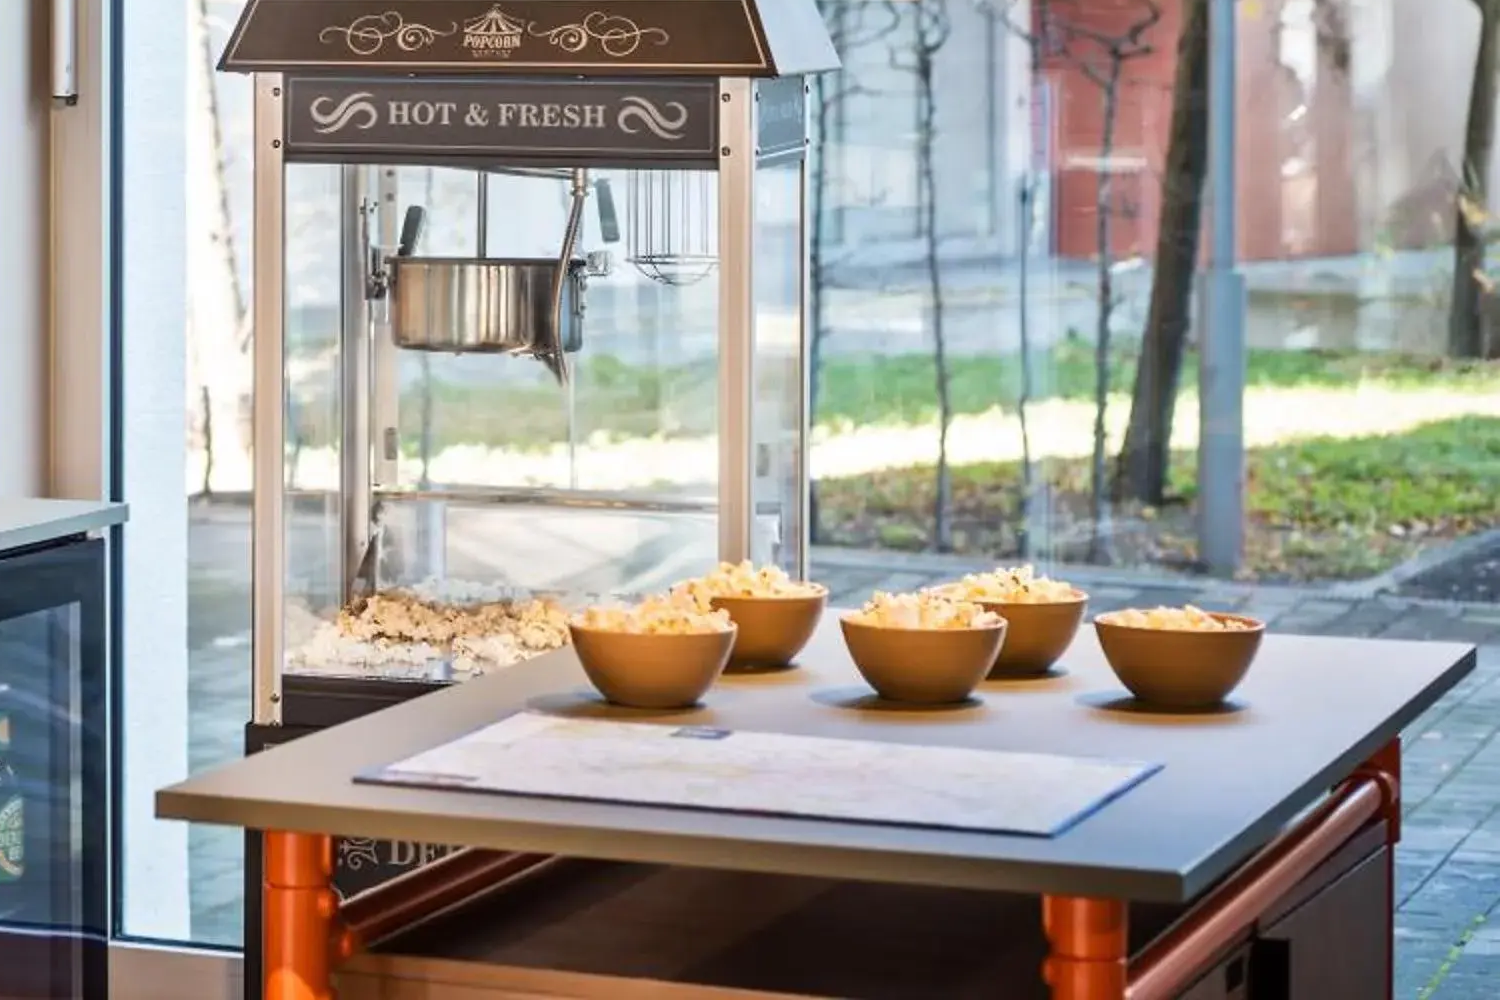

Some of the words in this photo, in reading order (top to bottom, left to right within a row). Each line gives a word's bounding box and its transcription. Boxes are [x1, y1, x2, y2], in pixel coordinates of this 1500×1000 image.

[463, 34, 521, 50] POPCORN
[387, 100, 457, 126] HOT
[464, 103, 489, 127] &
[498, 103, 606, 130] FRESH
